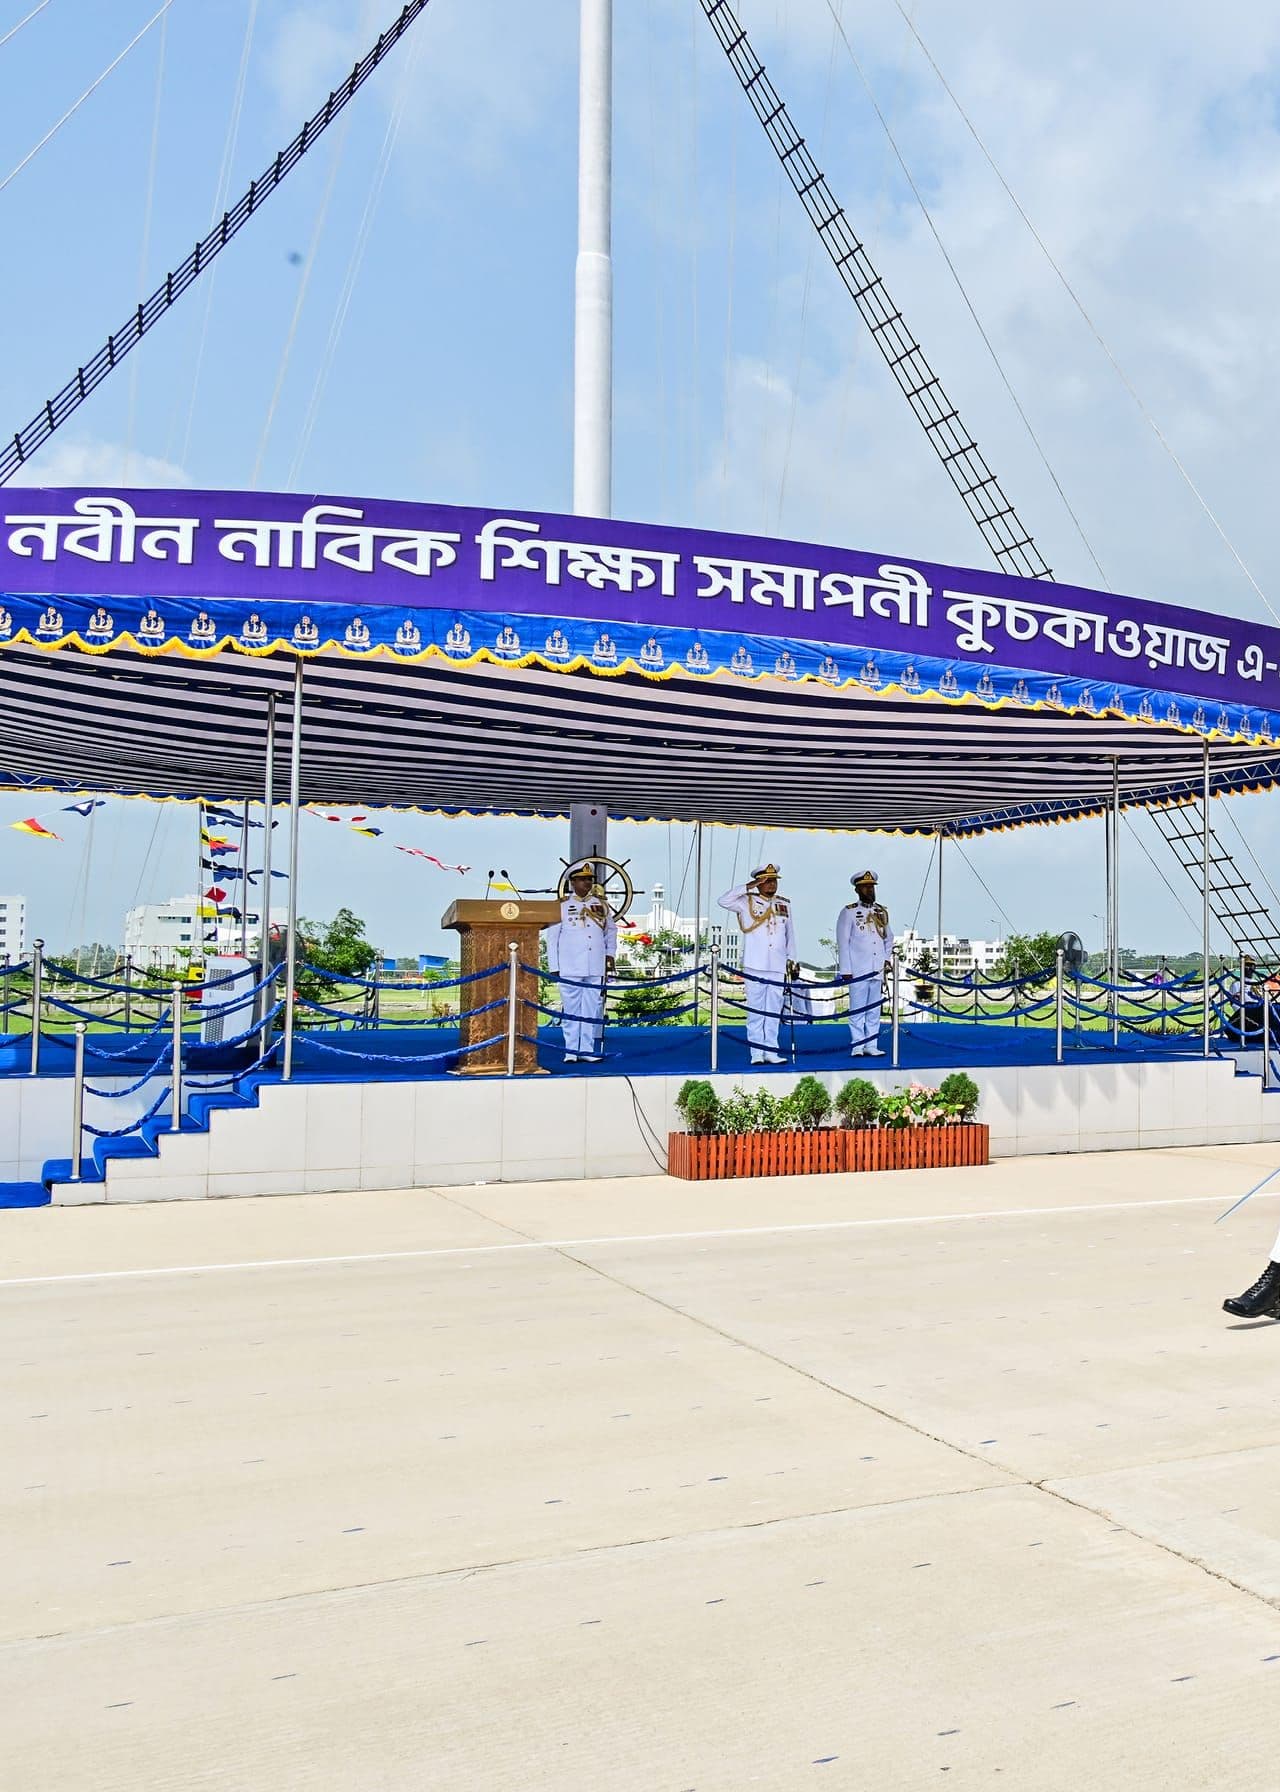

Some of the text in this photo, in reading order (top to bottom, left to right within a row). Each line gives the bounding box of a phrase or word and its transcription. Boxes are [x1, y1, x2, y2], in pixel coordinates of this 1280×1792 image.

[5, 497, 200, 564] নবীন
[214, 505, 461, 577] নাবিক
[475, 518, 681, 597] শিক্ষা
[692, 556, 933, 627] সমাপনী
[943, 589, 1231, 676] কুচকাওয়াজ
